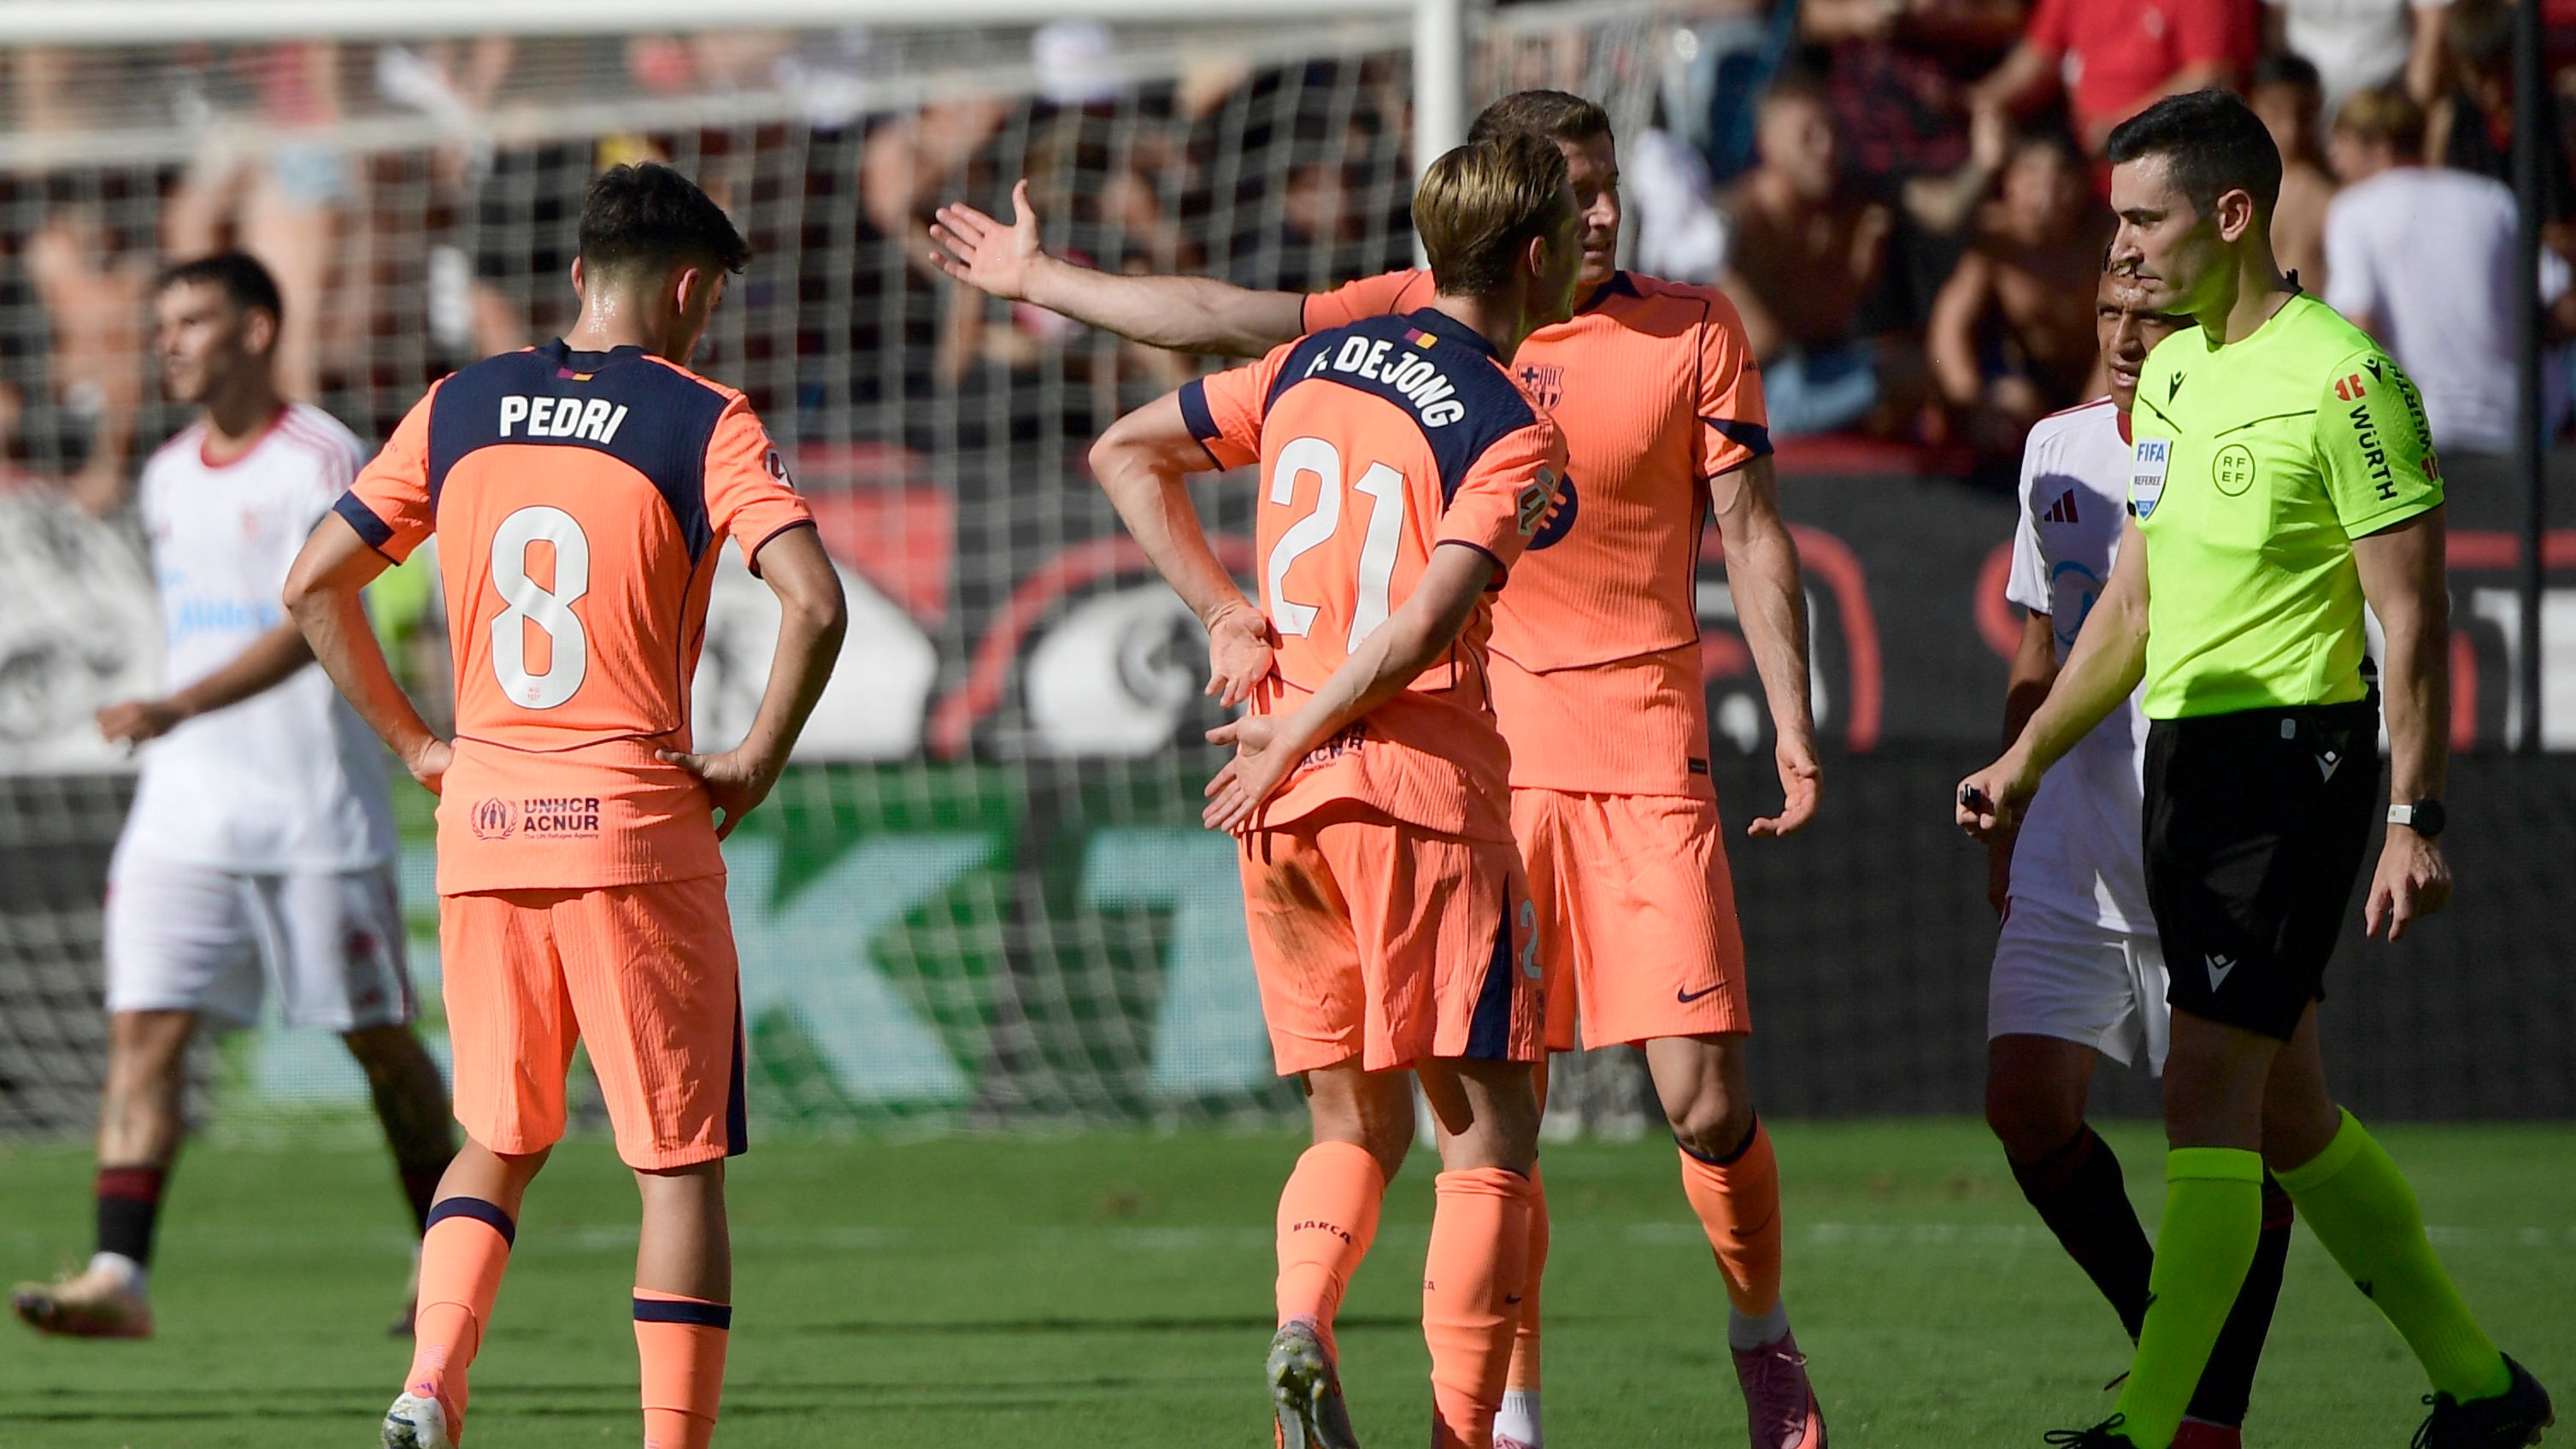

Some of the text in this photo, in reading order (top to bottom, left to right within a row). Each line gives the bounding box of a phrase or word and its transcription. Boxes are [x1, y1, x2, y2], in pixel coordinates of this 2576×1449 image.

[499, 395, 628, 445] PEDRI
[2137, 443, 2165, 462] FIFA
[2350, 404, 2397, 501] WÜRTH
[2134, 475, 2161, 486] REFEREE
[1268, 436, 1404, 655] 21
[490, 505, 590, 710] 8
[524, 798, 600, 813] UNHCR
[523, 815, 599, 832] ACNUR
